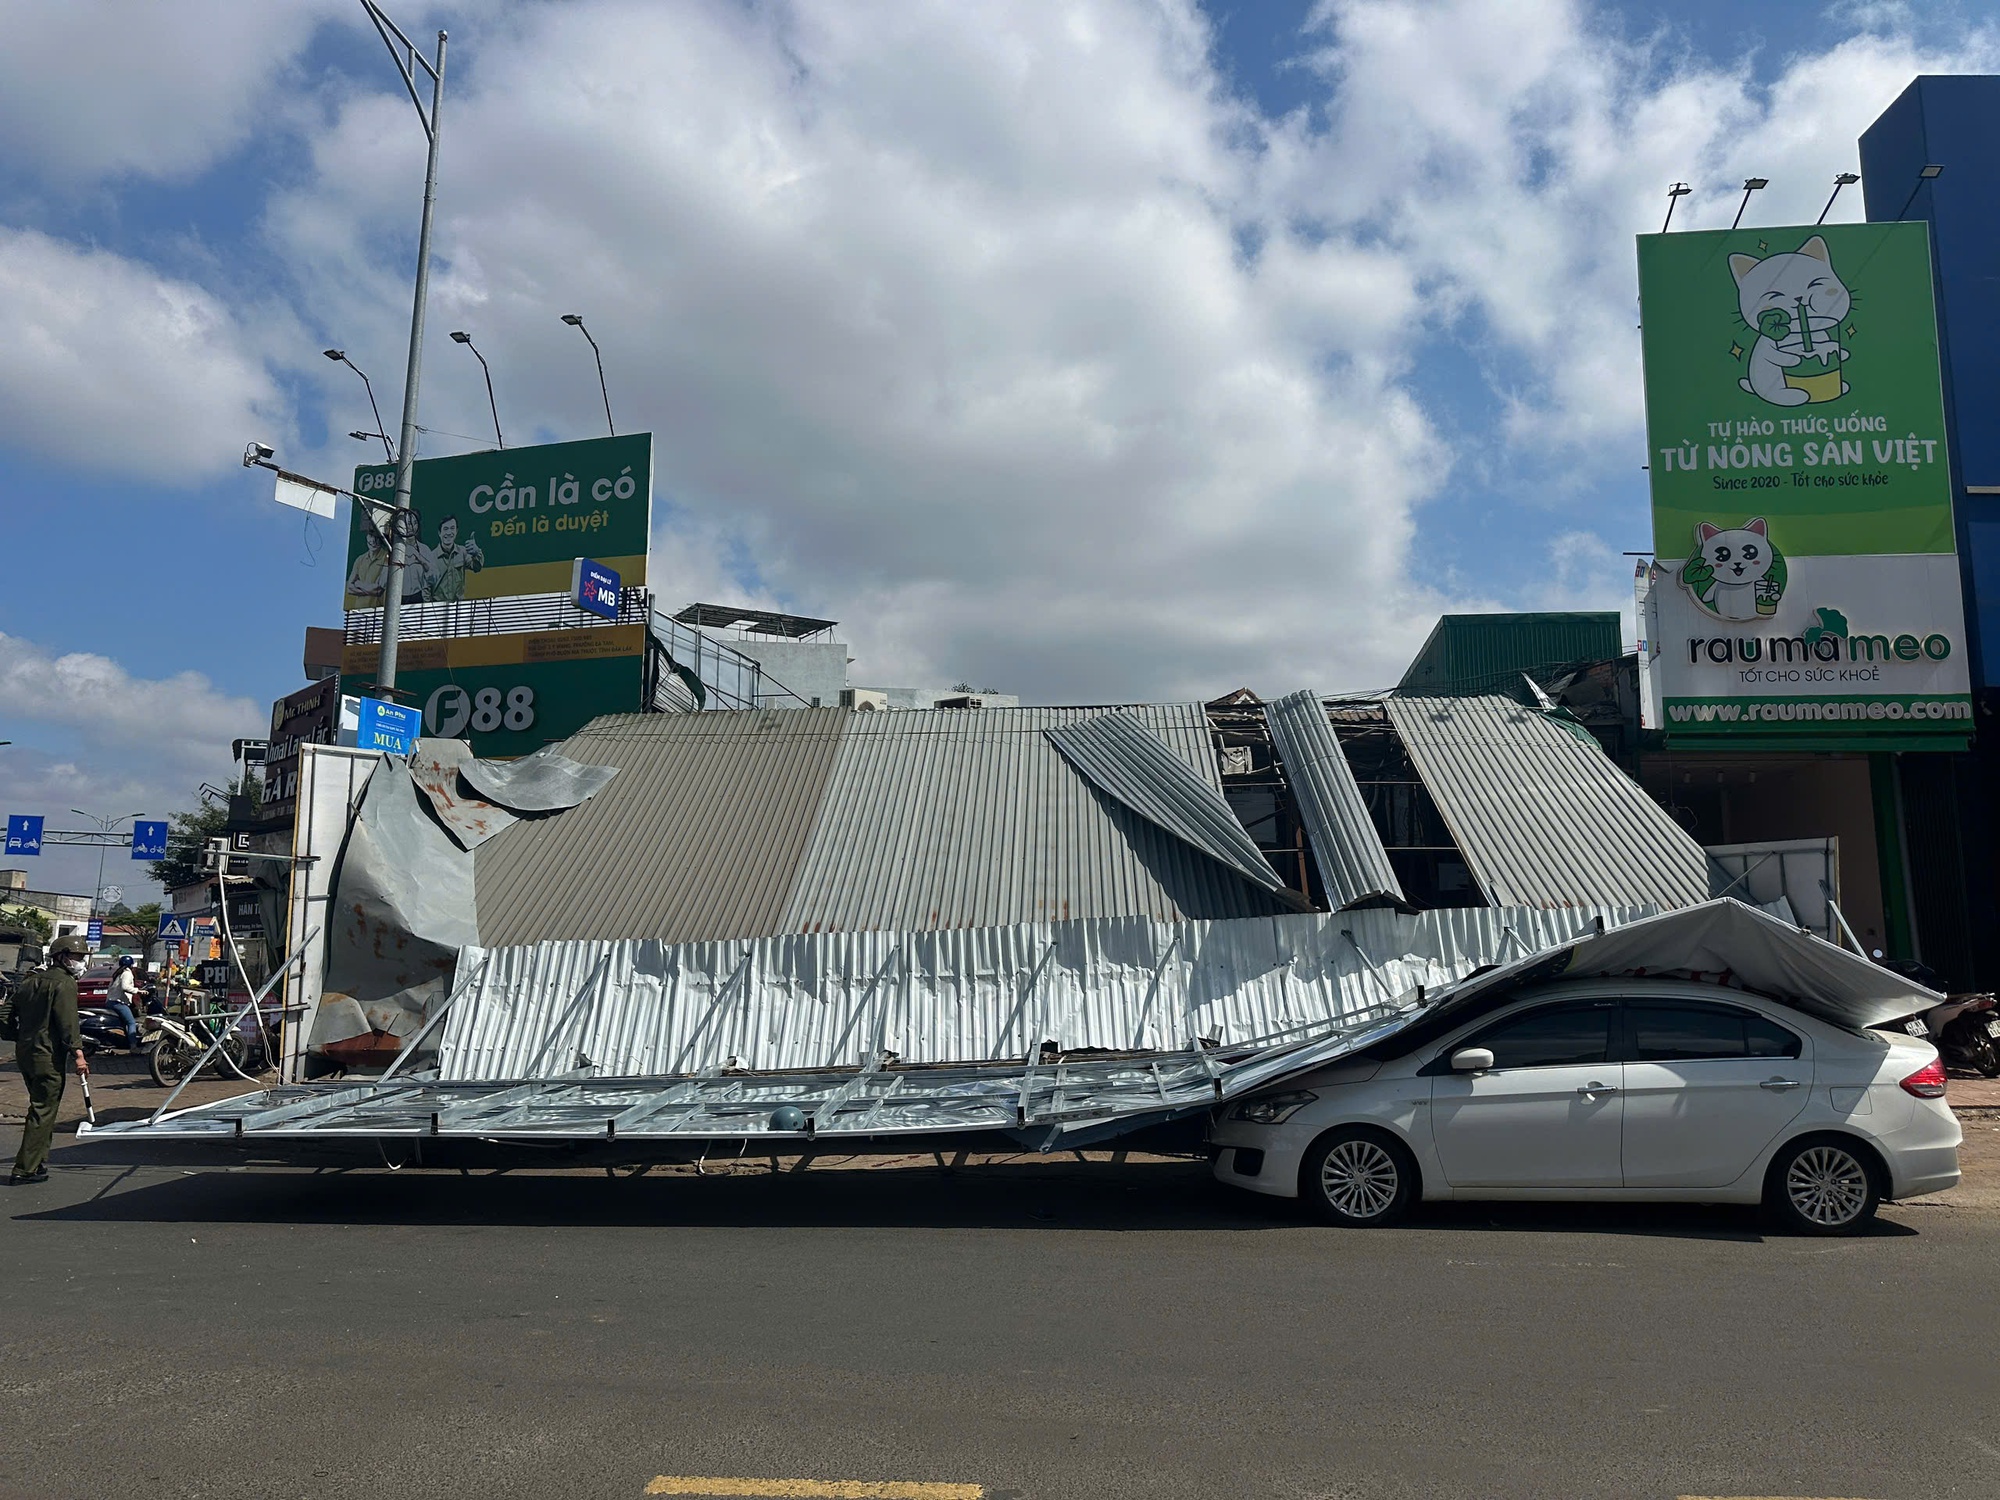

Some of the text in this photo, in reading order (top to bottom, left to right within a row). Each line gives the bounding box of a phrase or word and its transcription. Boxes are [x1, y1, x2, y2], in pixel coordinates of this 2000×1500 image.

[1707, 420, 1731, 441] TỰ
[1737, 416, 1774, 436] HÀO
[1780, 414, 1829, 435] THỨC
[1660, 432, 1937, 471] TỪ NÔNG SẢN VIỆT
[469, 466, 635, 514] Cần là có
[1713, 476, 1747, 490] Since
[1750, 476, 1780, 488] 2020
[1791, 472, 1810, 487] Tốt
[1814, 475, 1834, 487] cho
[1838, 471, 1859, 486] sức
[491, 510, 609, 537] Đến là duyệt
[598, 587, 615, 606] MB
[1739, 668, 1763, 683] TỐT
[1766, 670, 1800, 683] CHO
[1805, 667, 1834, 682] SỨC
[284, 695, 321, 721] Mr. THỊNH
[1668, 701, 1971, 722] www.raumameo.com
[373, 732, 402, 750] MUA
[260, 767, 281, 804] GÀ
